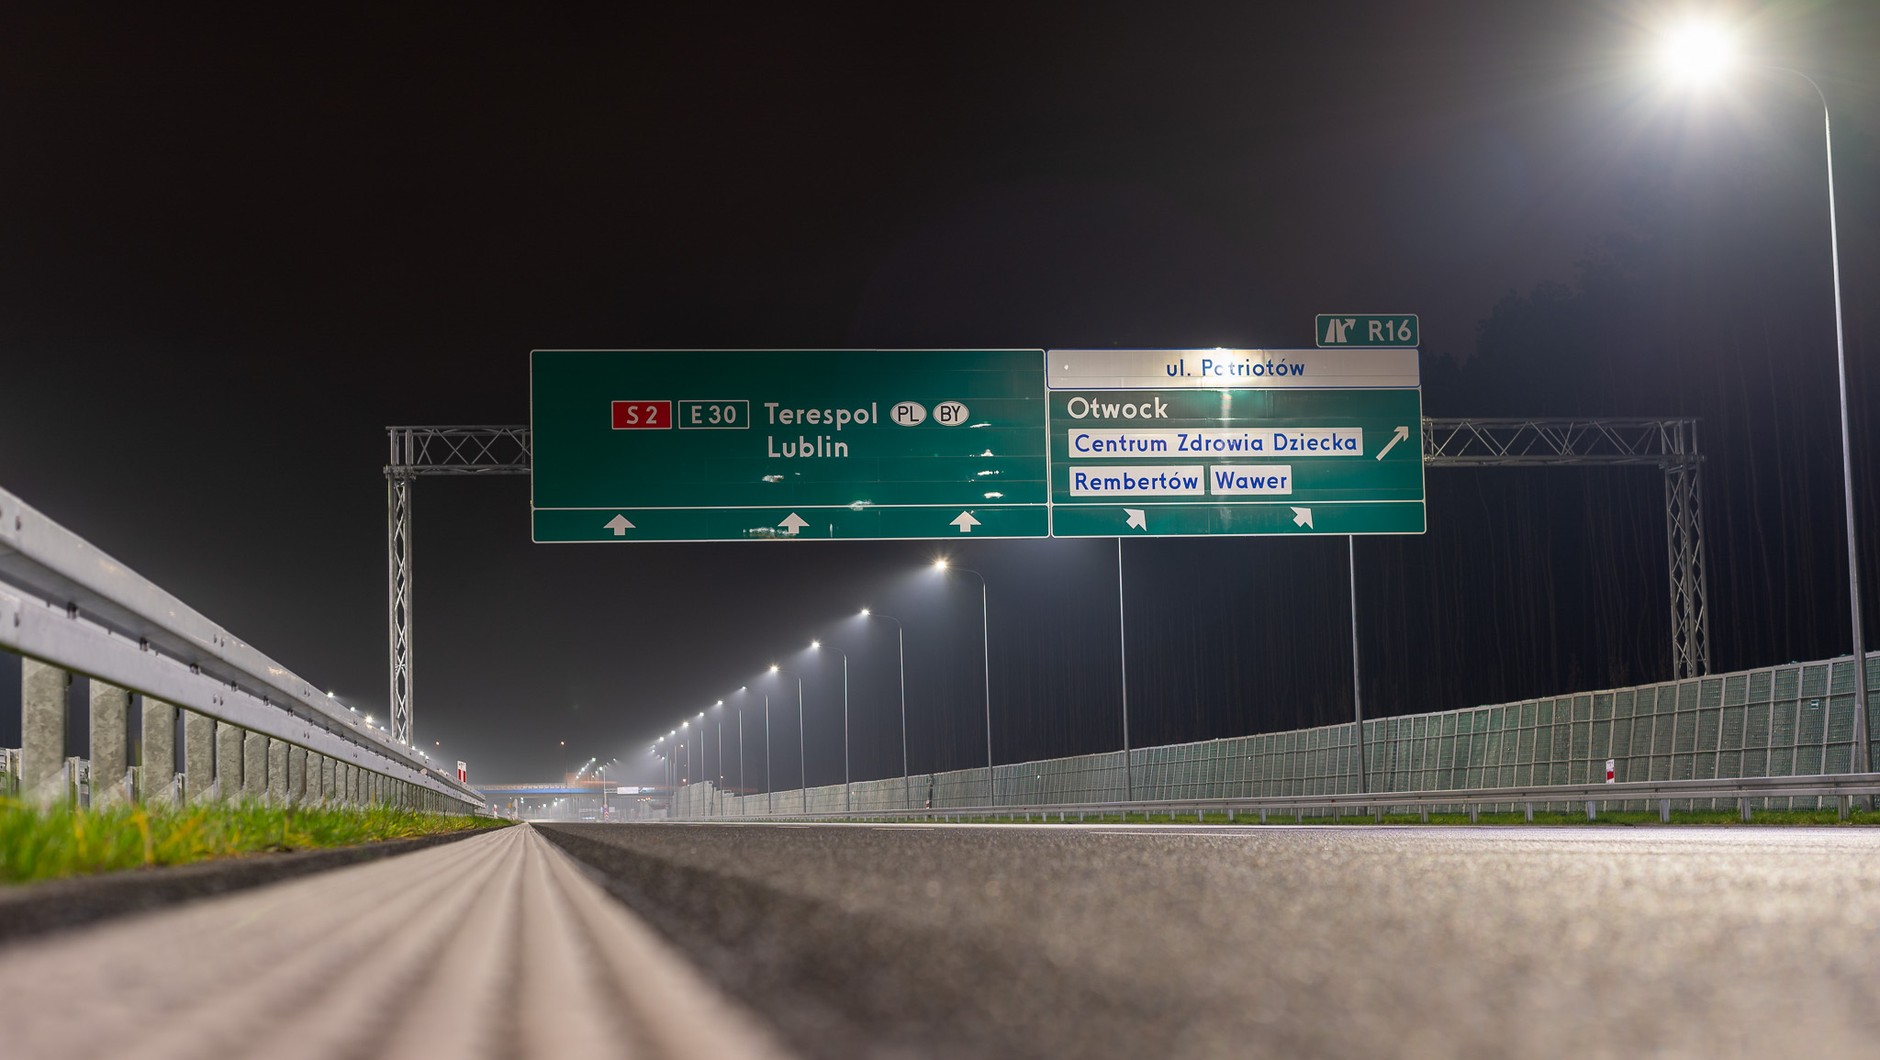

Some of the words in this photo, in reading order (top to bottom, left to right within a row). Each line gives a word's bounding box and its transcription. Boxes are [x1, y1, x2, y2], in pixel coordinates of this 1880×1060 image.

[1369, 320, 1412, 342] R16
[1166, 359, 1191, 377] ul.
[708, 405, 737, 424] 30
[764, 402, 877, 431] Terespol
[897, 405, 919, 422] PL
[940, 405, 961, 422] BY
[1067, 397, 1168, 419] Otwock
[768, 436, 848, 458] Lublin
[1075, 434, 1168, 453] Centrum
[1177, 434, 1264, 452] Zdrowia
[1273, 433, 1357, 451] Dziecka
[1075, 472, 1198, 491] Rembertów
[1215, 472, 1288, 489] Wawer
